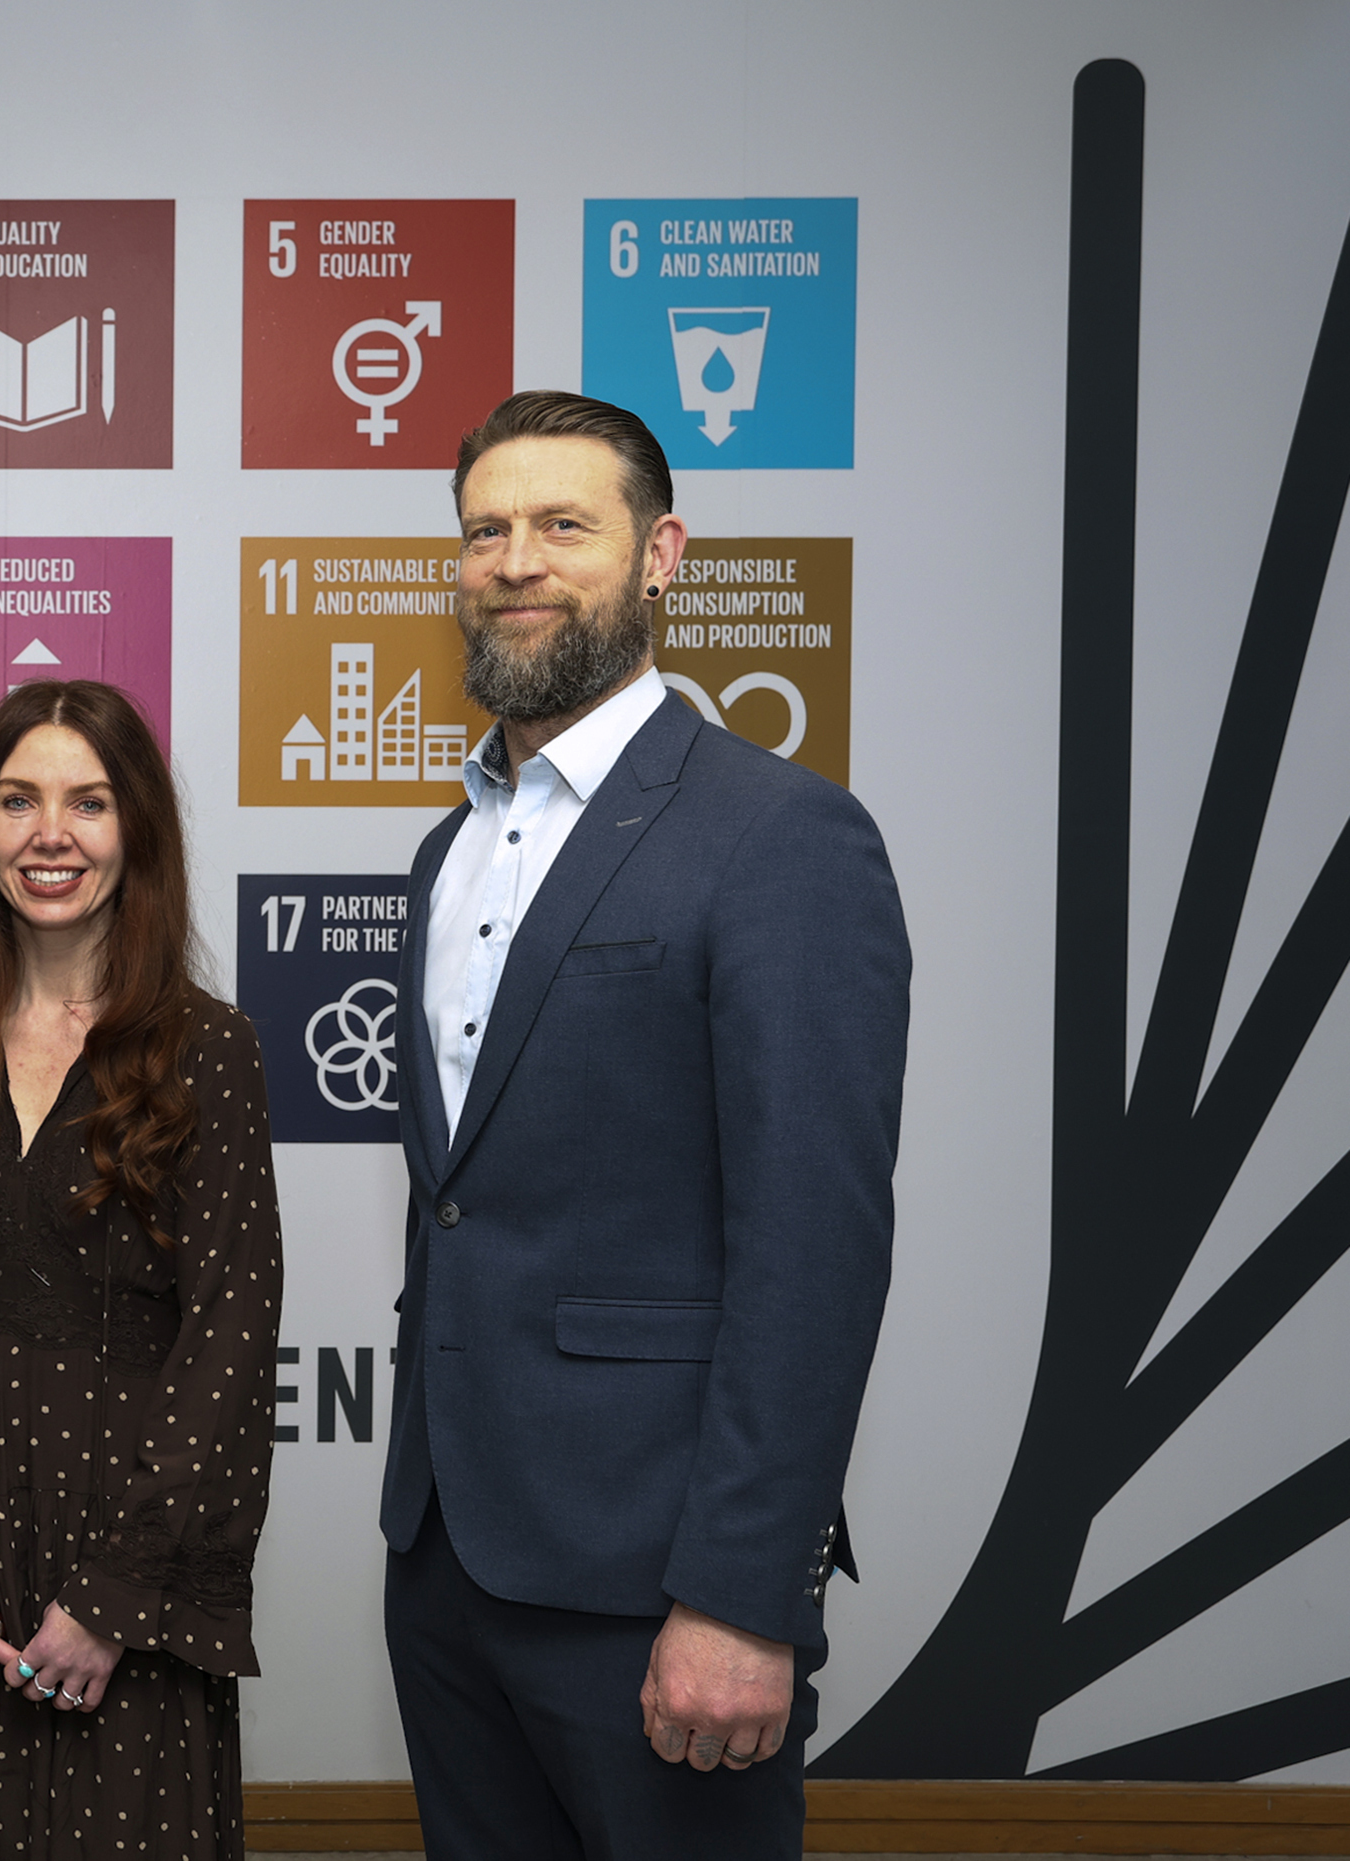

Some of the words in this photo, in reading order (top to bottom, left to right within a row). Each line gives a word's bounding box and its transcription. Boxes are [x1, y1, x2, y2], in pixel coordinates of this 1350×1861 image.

[320, 221, 394, 244] GENDER
[661, 220, 722, 244] CLEAN
[729, 220, 793, 244] WATER
[269, 222, 296, 277] 5
[610, 221, 638, 277] 6
[320, 254, 411, 279] EQUALITY
[660, 253, 700, 277] AND
[707, 253, 819, 277] SANITATION
[314, 559, 437, 582] SUSTAINABLE
[672, 559, 797, 583] ESPONSIBLE
[259, 559, 297, 614] 11
[314, 592, 353, 615] AND
[358, 592, 456, 615] COMMUNIT
[665, 591, 804, 615] CONSUMPTION
[665, 624, 704, 648] AND
[709, 624, 831, 648] PRODUCTION
[323, 896, 407, 919] PARTNER
[262, 896, 305, 951] 17
[323, 928, 358, 951] FOR
[363, 928, 397, 951] THE
[275, 1347, 398, 1442] EN
